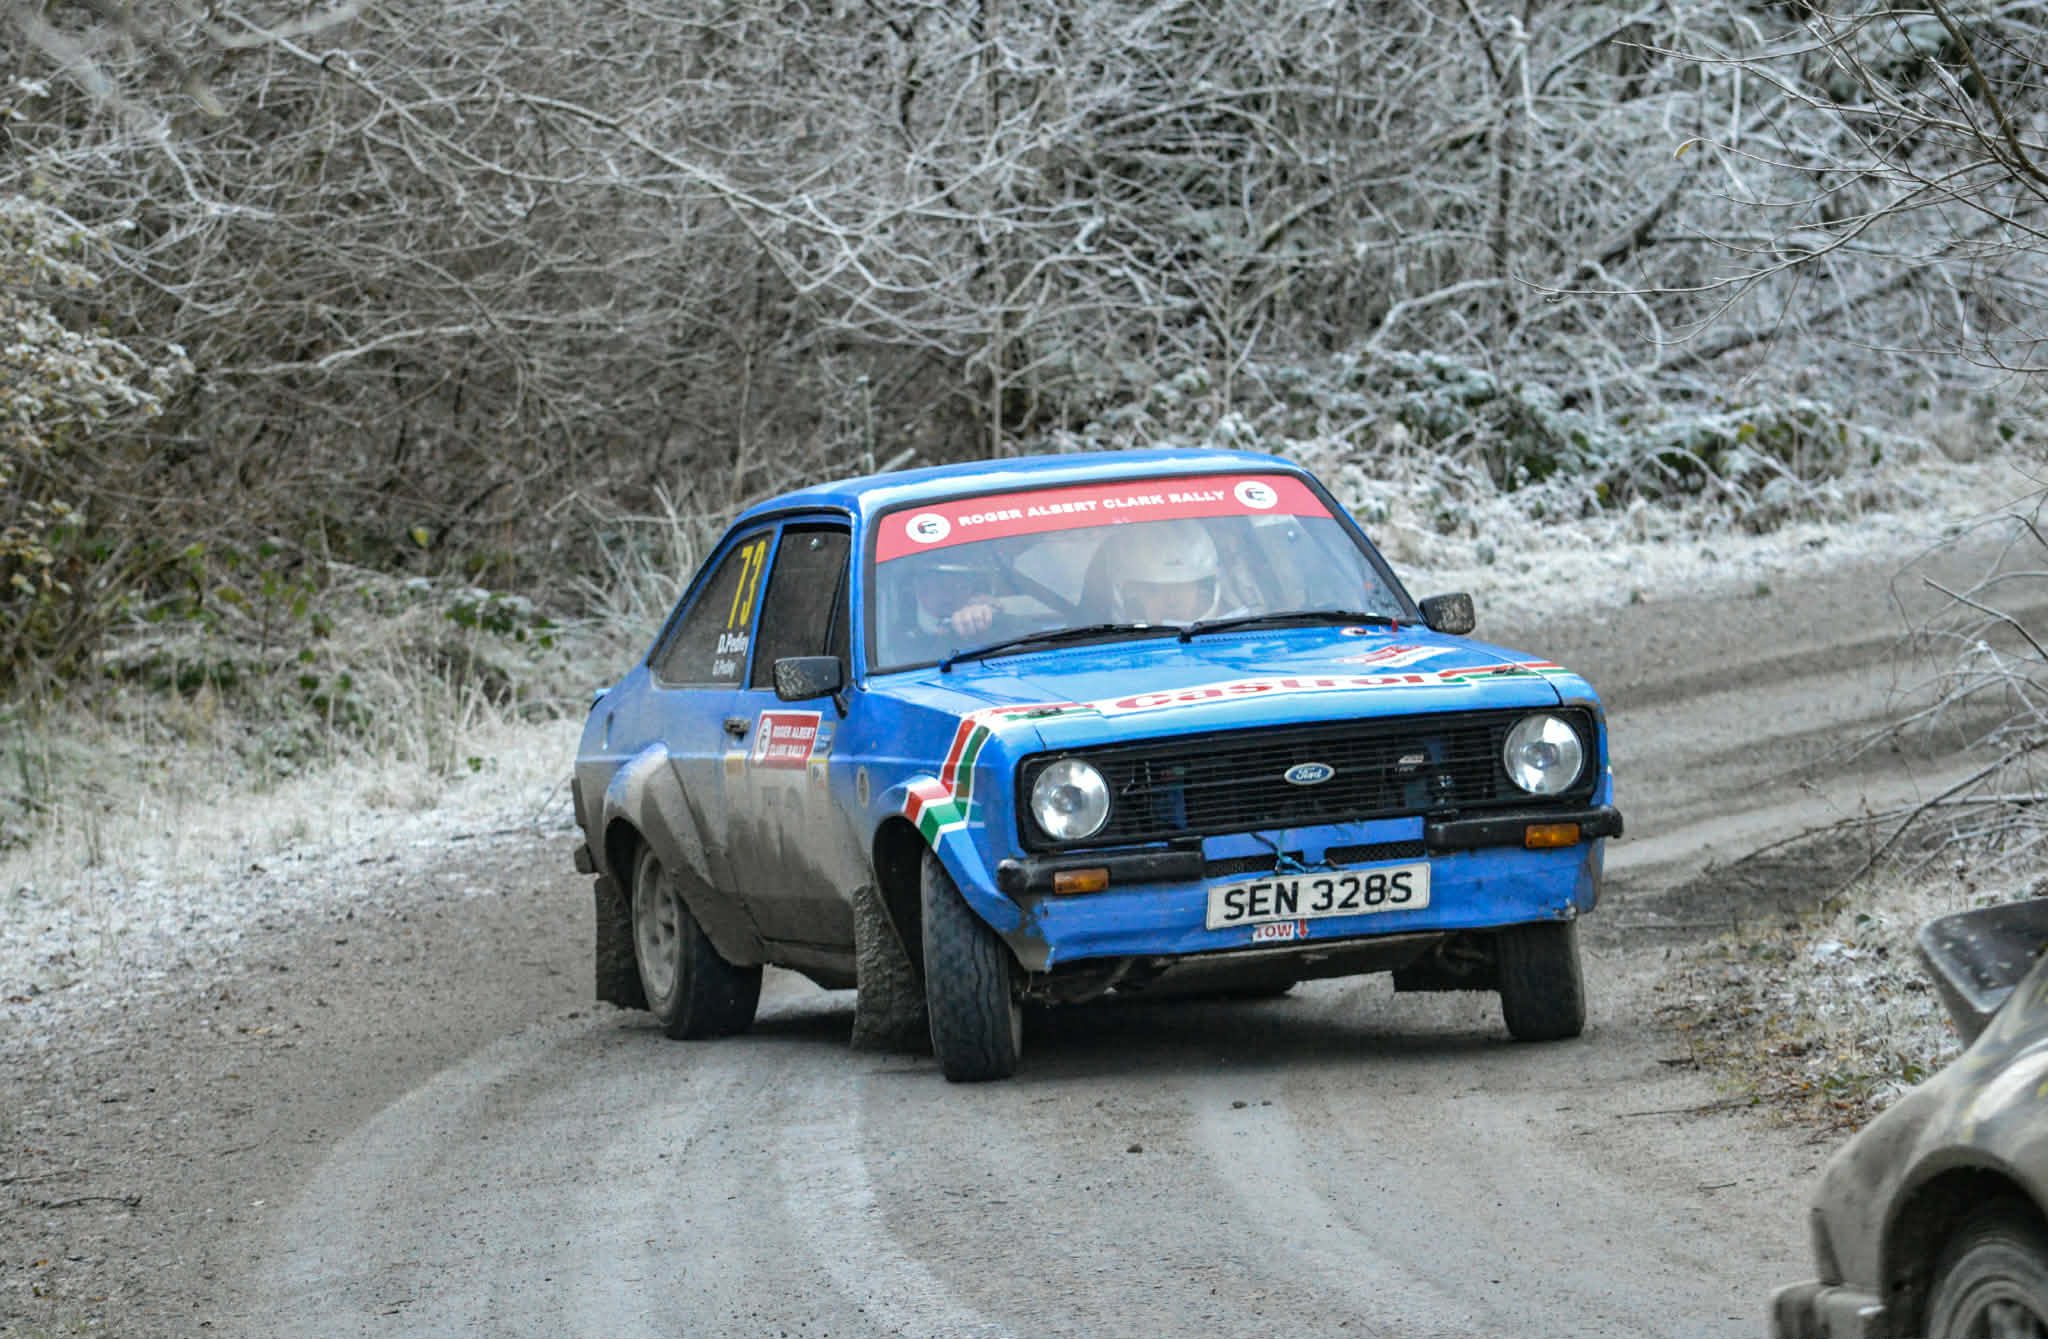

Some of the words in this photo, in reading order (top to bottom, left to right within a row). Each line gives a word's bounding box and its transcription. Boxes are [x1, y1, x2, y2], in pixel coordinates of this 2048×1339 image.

[958, 509, 1023, 527] ROGER
[1027, 500, 1097, 517] ALBERT
[1102, 494, 1165, 509] CLARK
[1168, 490, 1224, 504] RALLY
[727, 540, 766, 629] 73
[1115, 675, 1425, 709] Castrol
[1296, 766, 1323, 780] Ford
[1224, 881, 1299, 920] SEN
[1311, 872, 1413, 912] 328S
[1255, 923, 1293, 938] TOW
